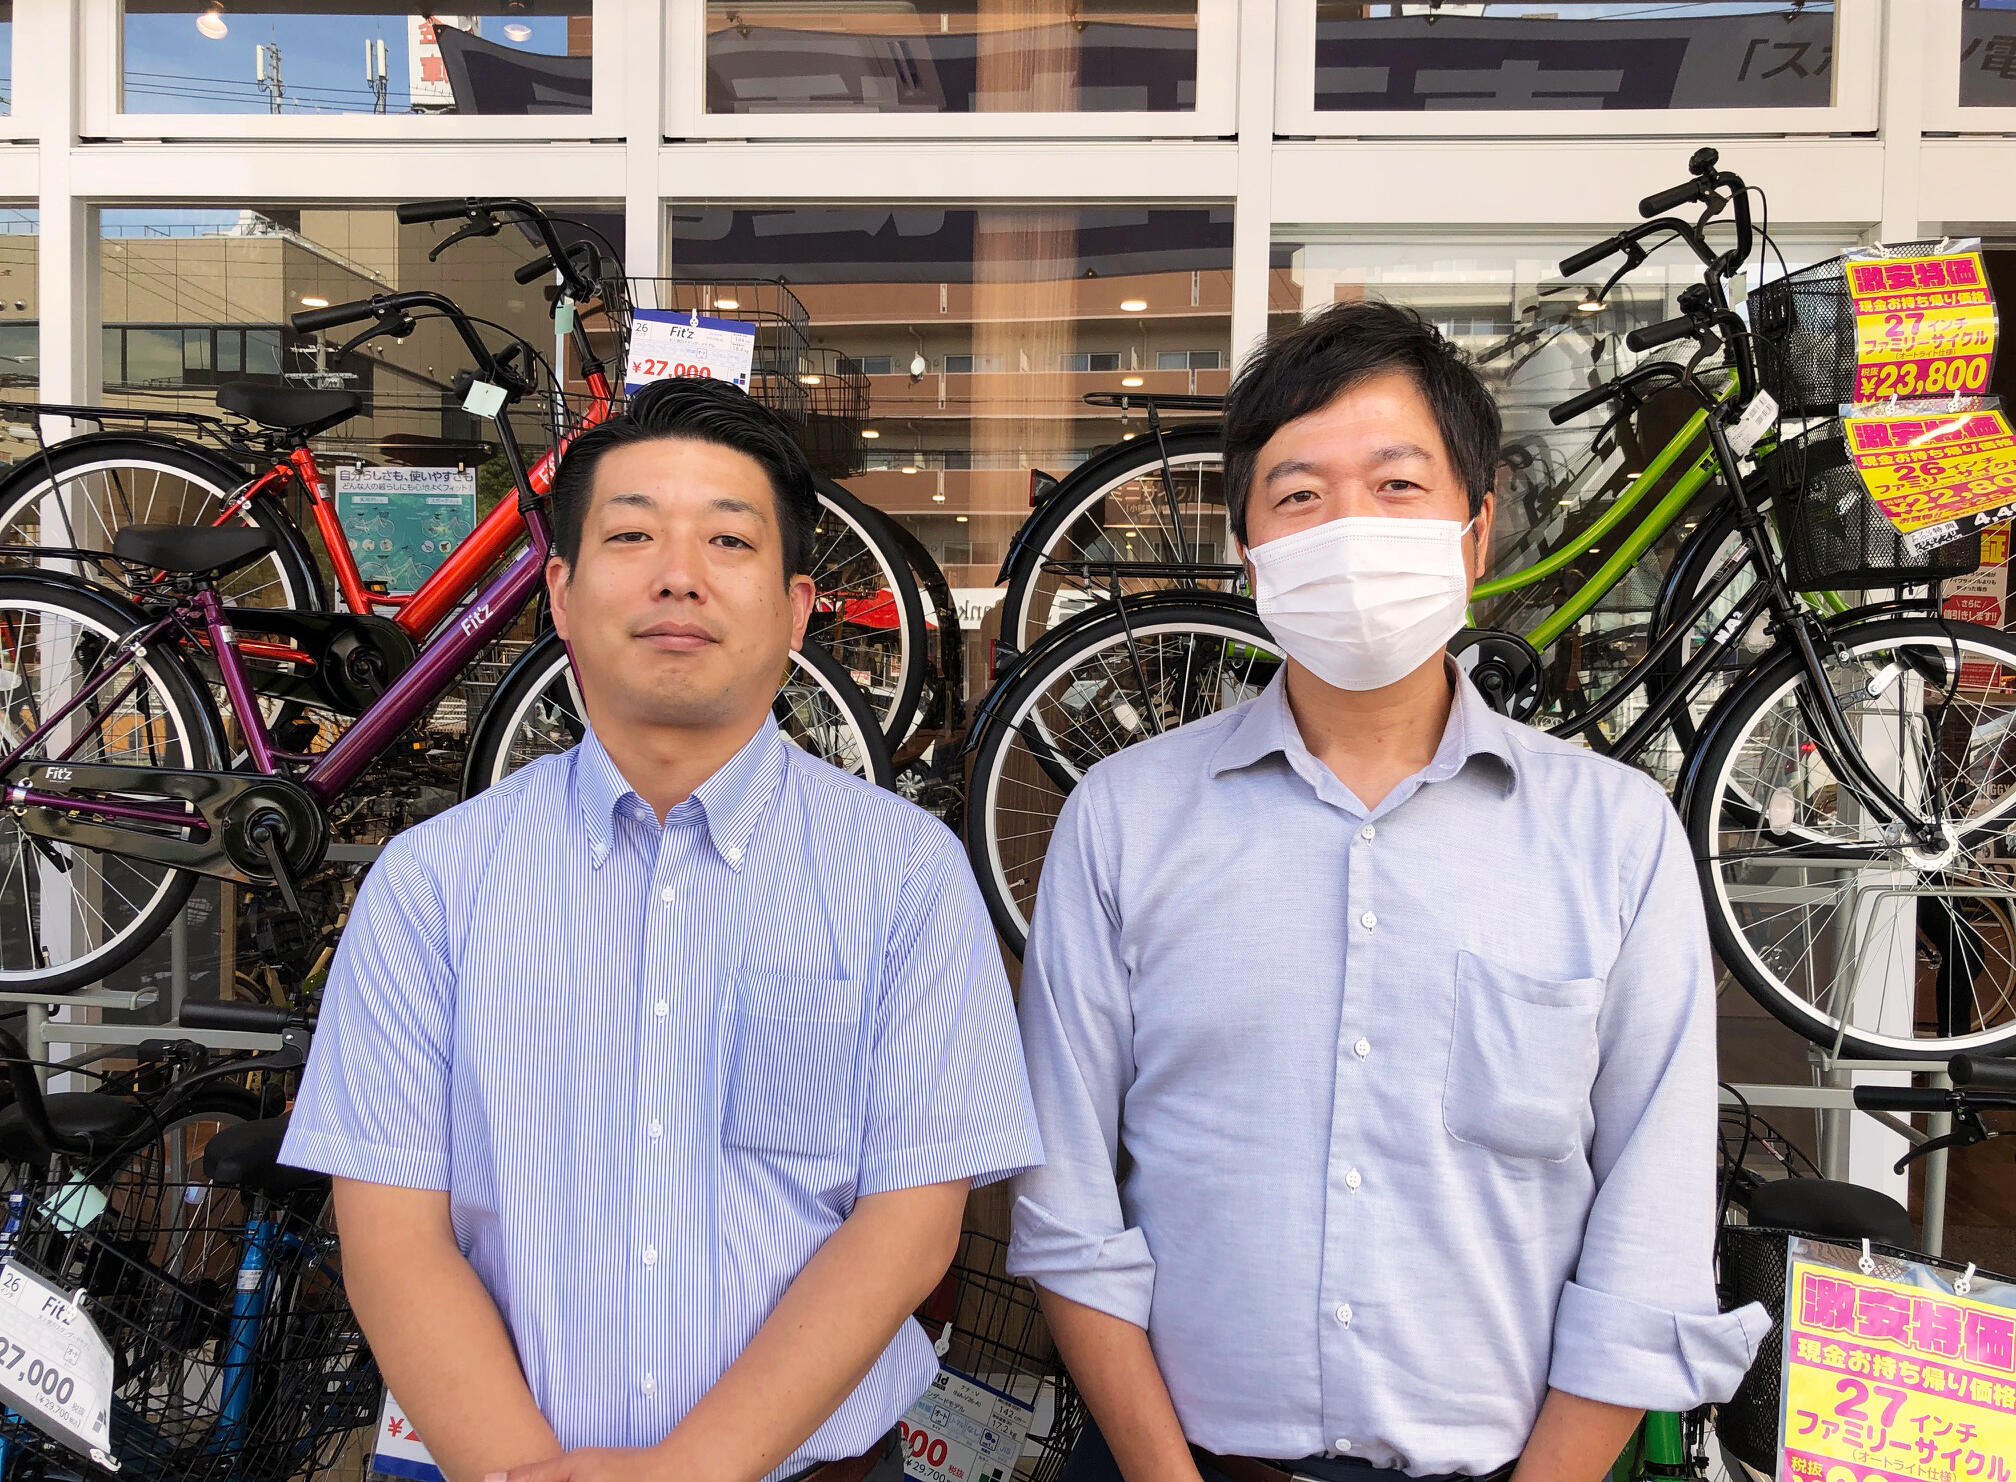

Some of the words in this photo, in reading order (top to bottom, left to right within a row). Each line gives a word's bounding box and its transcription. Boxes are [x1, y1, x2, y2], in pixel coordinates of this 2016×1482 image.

[1852, 257, 1979, 294] 激安特価
[1857, 291, 1987, 313] 現金お持ち帰り価格
[635, 322, 649, 333] 26
[669, 326, 695, 340] Fit'z
[1884, 312, 1925, 338] 27
[1927, 317, 1968, 332] インチ
[1864, 331, 1989, 356] ファミリーサイクル
[1860, 357, 1988, 397] ¥23,800
[1893, 461, 1947, 482] 26
[460, 602, 495, 638] Fit'z
[45, 766, 73, 780] Fit'z
[3, 1272, 21, 1293] 26
[1800, 1272, 2015, 1373] 激安特価
[1797, 1338, 2016, 1410] 現金お持ち帰り価格
[1834, 1378, 1908, 1428] 27
[1910, 1414, 1978, 1443] インチ
[1796, 1409, 2011, 1482] ファミリーサイクル
